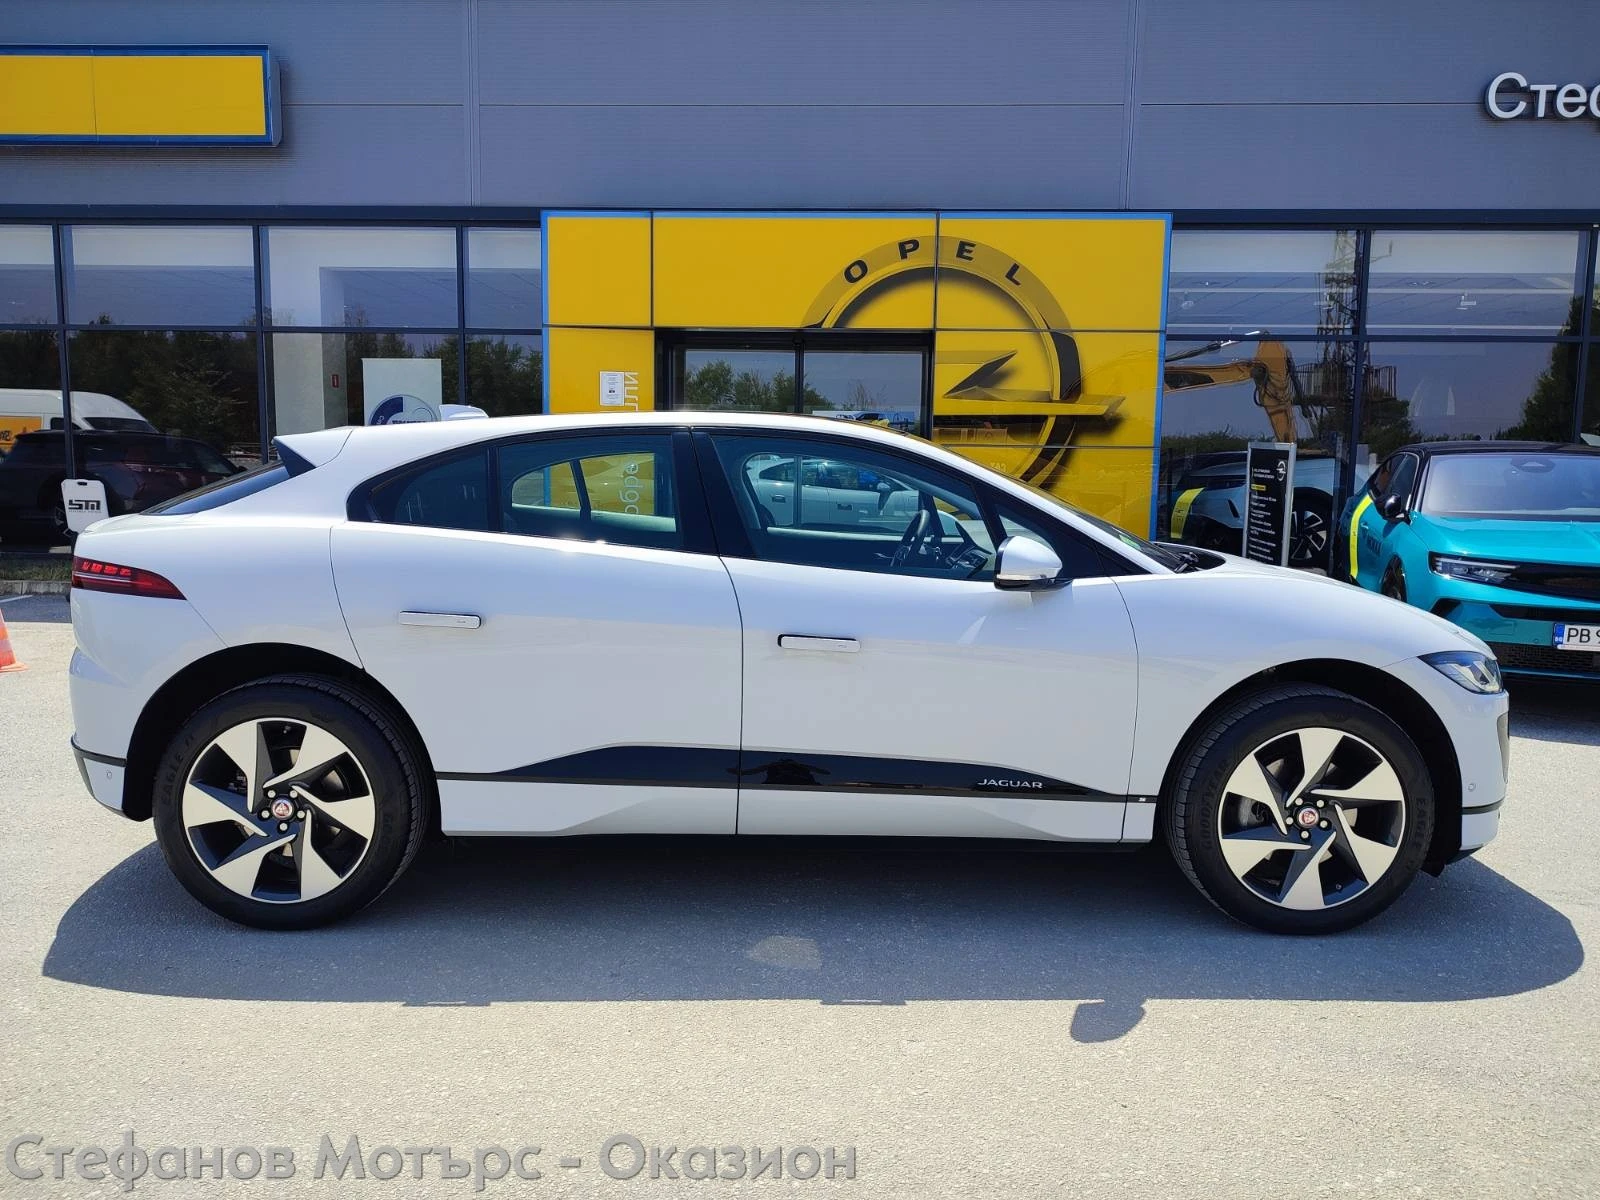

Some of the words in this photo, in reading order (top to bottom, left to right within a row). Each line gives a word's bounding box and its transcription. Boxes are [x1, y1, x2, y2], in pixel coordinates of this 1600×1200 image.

[844, 239, 1021, 286] OPEL
[1566, 627, 1591, 643] PB
[977, 778, 1043, 789] JAGUAR
